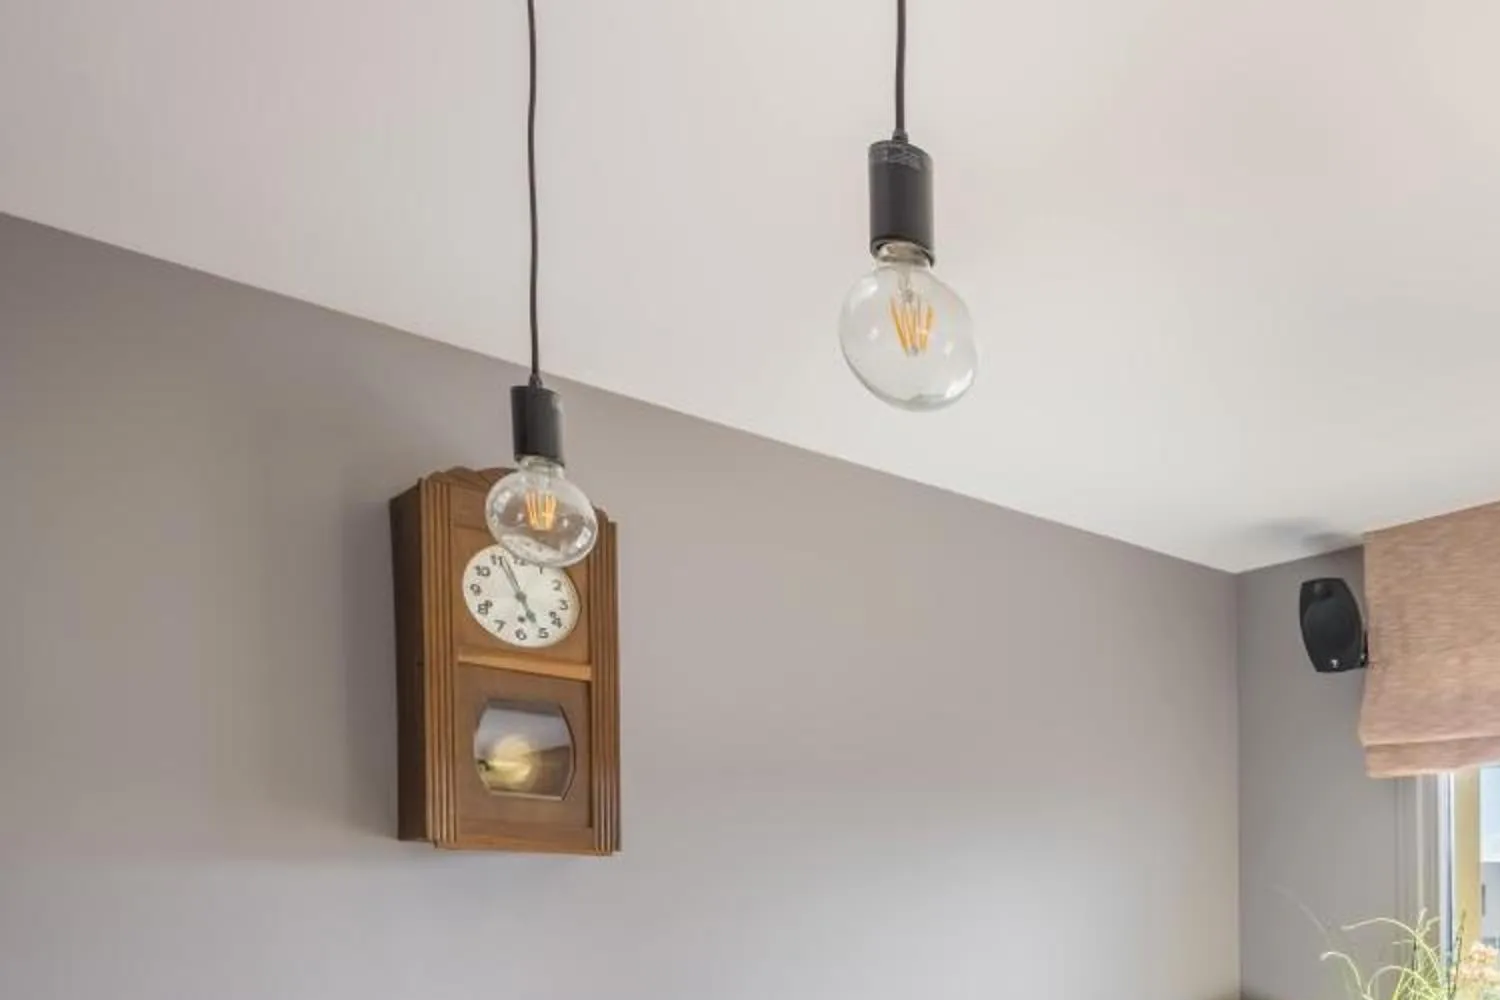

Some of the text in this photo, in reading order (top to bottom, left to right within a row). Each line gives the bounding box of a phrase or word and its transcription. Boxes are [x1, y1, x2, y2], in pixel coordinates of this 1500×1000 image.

[551, 579, 561, 591] 2
[495, 619, 506, 632] 7
[515, 629, 527, 641] 6
[538, 627, 549, 639] 5
